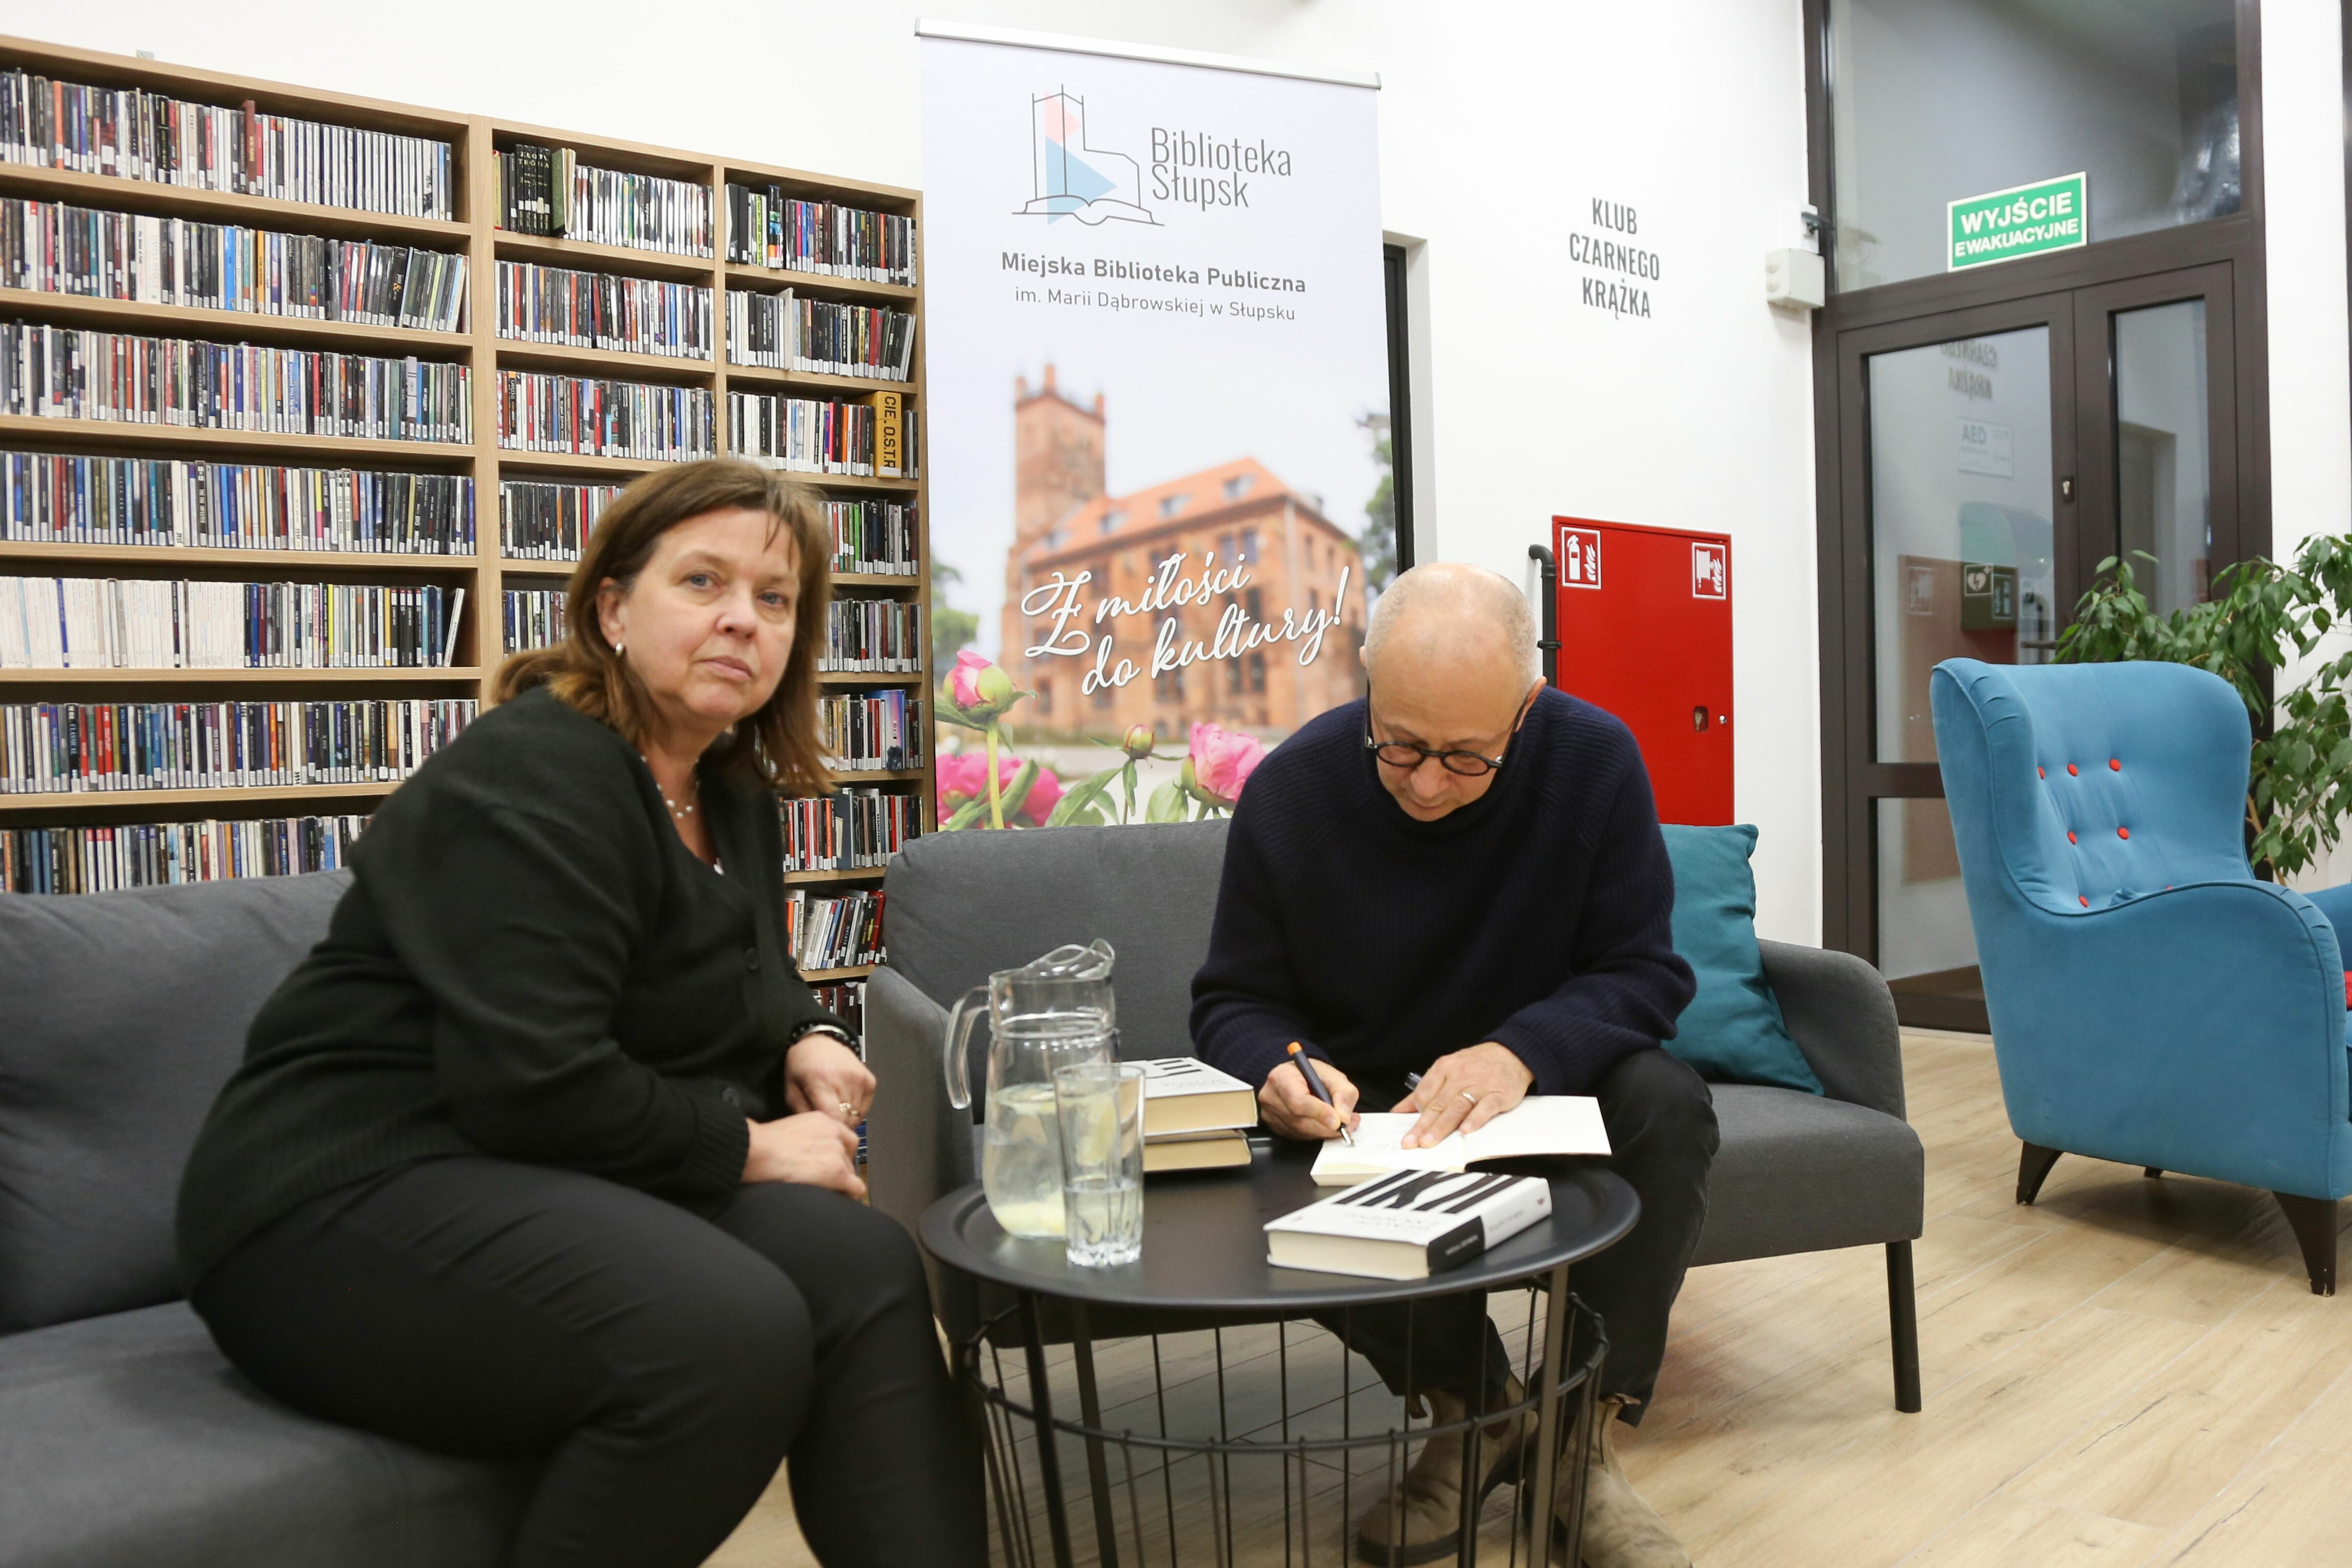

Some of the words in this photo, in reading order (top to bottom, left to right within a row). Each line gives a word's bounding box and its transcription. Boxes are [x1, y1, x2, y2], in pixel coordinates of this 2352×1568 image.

[1151, 126, 1292, 177] Biblioteka
[1151, 163, 1249, 212] Słupsk
[1593, 197, 1637, 235] KLUB
[1960, 191, 2072, 235] WYJŚCIE
[1569, 232, 1660, 281] CZARNEGO
[1954, 218, 2079, 258] EWAKUACYJNE
[1001, 251, 1086, 278] Miejska
[1093, 259, 1199, 285] Biblioteka
[1207, 267, 1306, 293] Publiczna
[1015, 286, 1042, 304] im.
[1048, 288, 1091, 307] Marii
[1098, 292, 1204, 317] Dąbrowskiej
[1210, 304, 1223, 315] w
[1230, 301, 1296, 321] Słupsku
[1583, 276, 1651, 321] KRĄŻKA
[884, 396, 897, 424] CIE.
[1962, 424, 1987, 444] AED
[1020, 570, 1092, 658] Z
[1095, 550, 1251, 624] miłości
[1081, 633, 1140, 695] do
[1151, 565, 1350, 679] kultury!
[69, 723, 77, 755] CLASSICAL
